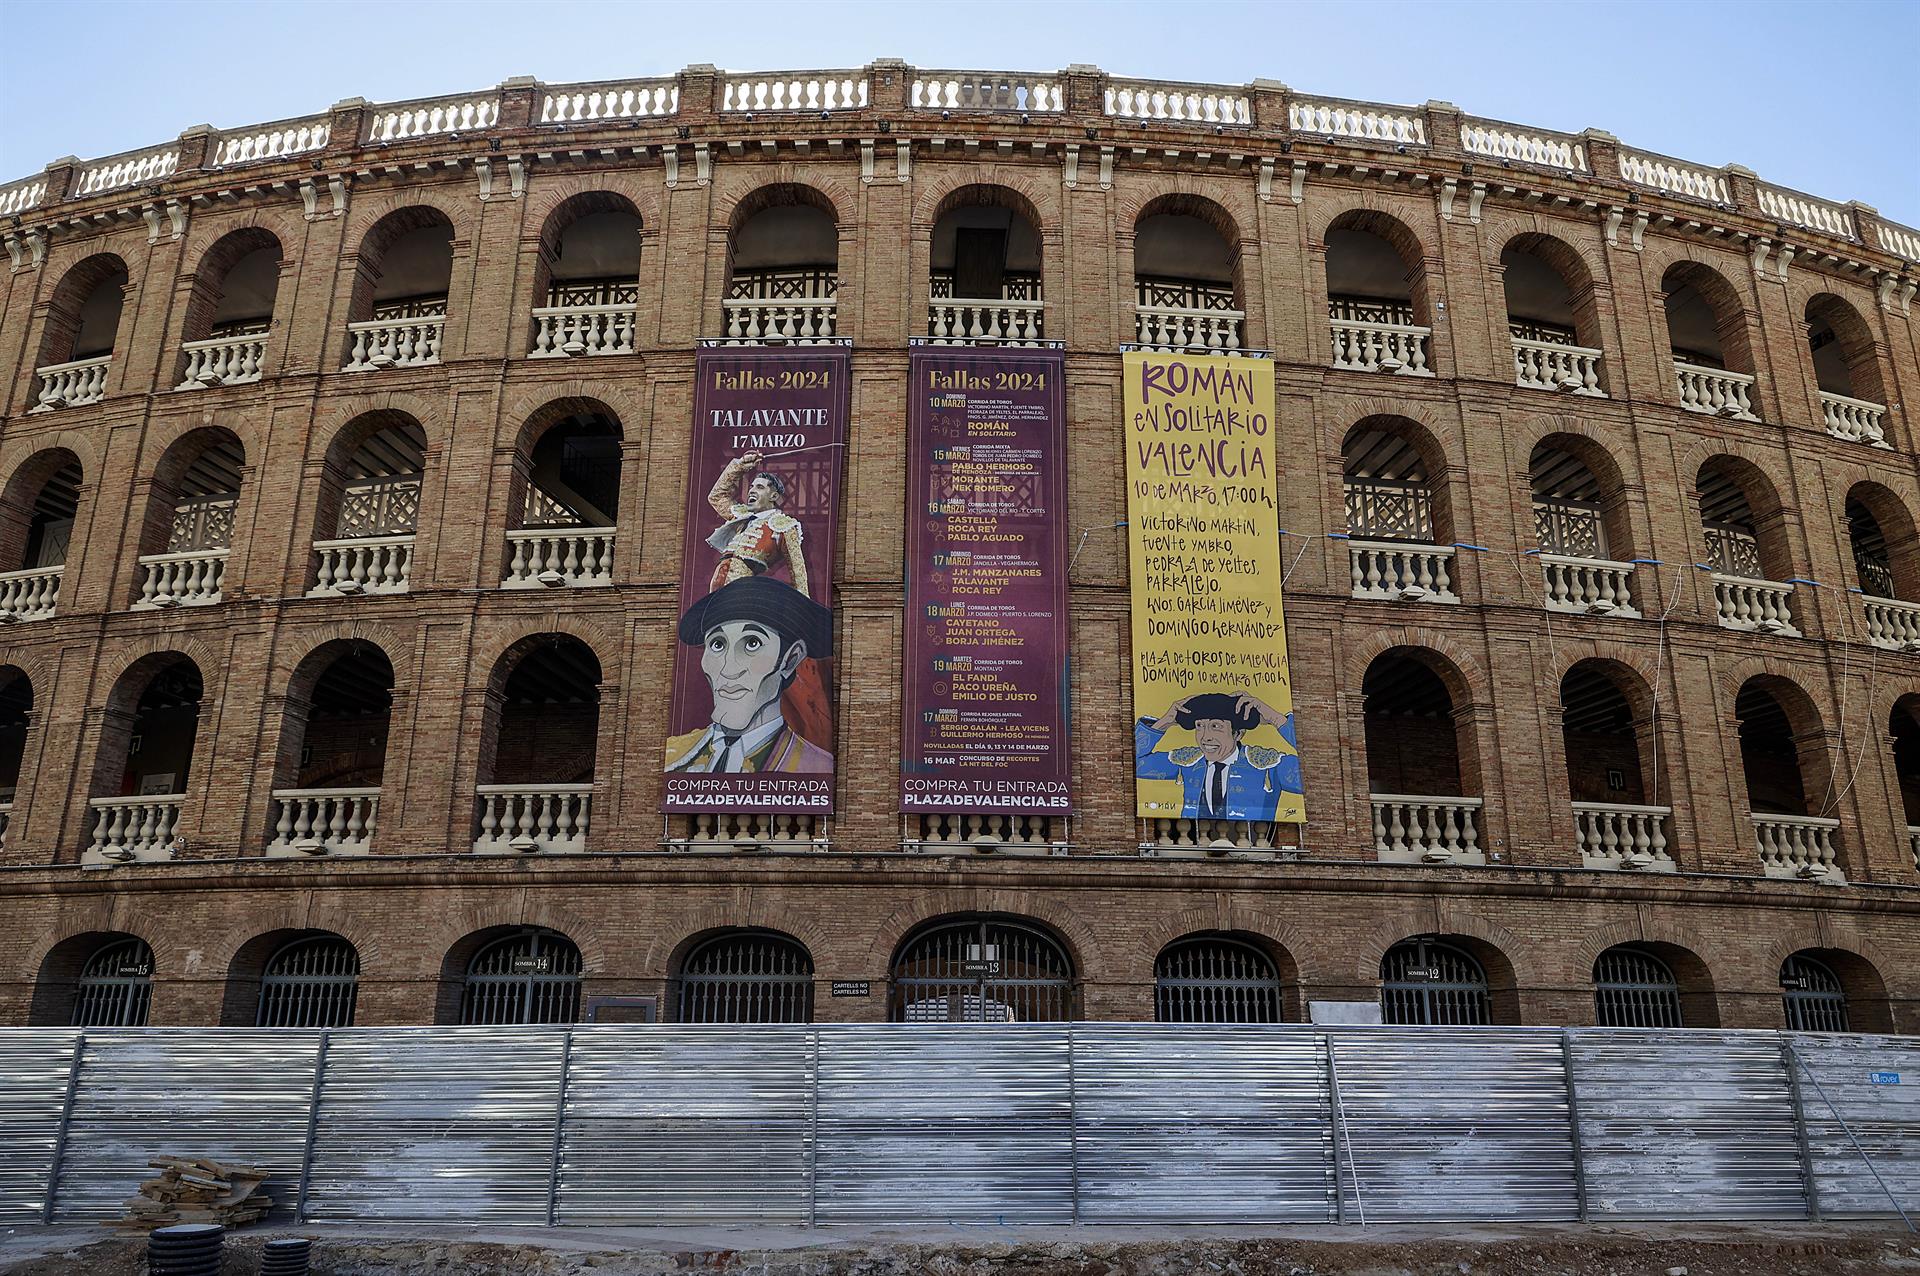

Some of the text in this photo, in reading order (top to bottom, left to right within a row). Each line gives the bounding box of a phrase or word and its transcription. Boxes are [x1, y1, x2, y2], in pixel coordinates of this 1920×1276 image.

[714, 370, 830, 390] Fallas 2024
[929, 370, 1046, 391] Fallas 2024
[1142, 360, 1254, 405] ROMÁN
[930, 398, 966, 408] 10 MARZO
[710, 408, 828, 427] TALAVANTE
[968, 420, 1009, 430] ROMÁN
[732, 434, 806, 448] 17 MARZO
[934, 450, 944, 460] 15
[946, 452, 970, 460] MARZO
[1134, 480, 1148, 498] 10
[1169, 481, 1220, 506] MARZO,
[1222, 486, 1256, 506] 17:00
[928, 503, 965, 513] 16 MARZO
[933, 555, 971, 566] 17 MARZO
[927, 606, 964, 617] 18 MARZO
[982, 637, 1024, 645] JIMÉNEZ
[1141, 650, 1170, 667] PLAZA
[933, 660, 971, 671] 19 MARZO
[1198, 671, 1207, 683] 10
[1220, 673, 1250, 687] MARZO
[1253, 671, 1276, 687] 17:00
[982, 682, 1017, 691] UREÑA
[924, 712, 934, 722] 17
[667, 780, 829, 792] COMPRA TU ENTRADA
[905, 780, 1068, 792] COMPRA TU ENTRADA
[666, 794, 829, 806] PLAZADEVALENCIA.ES
[904, 794, 1068, 807] PLAZADEVALENCIA.ES
[138, 964, 149, 974] 15
[537, 959, 547, 969] 14
[989, 962, 999, 972] 13
[1429, 969, 1439, 979] 12
[1799, 978, 1807, 987] 11
